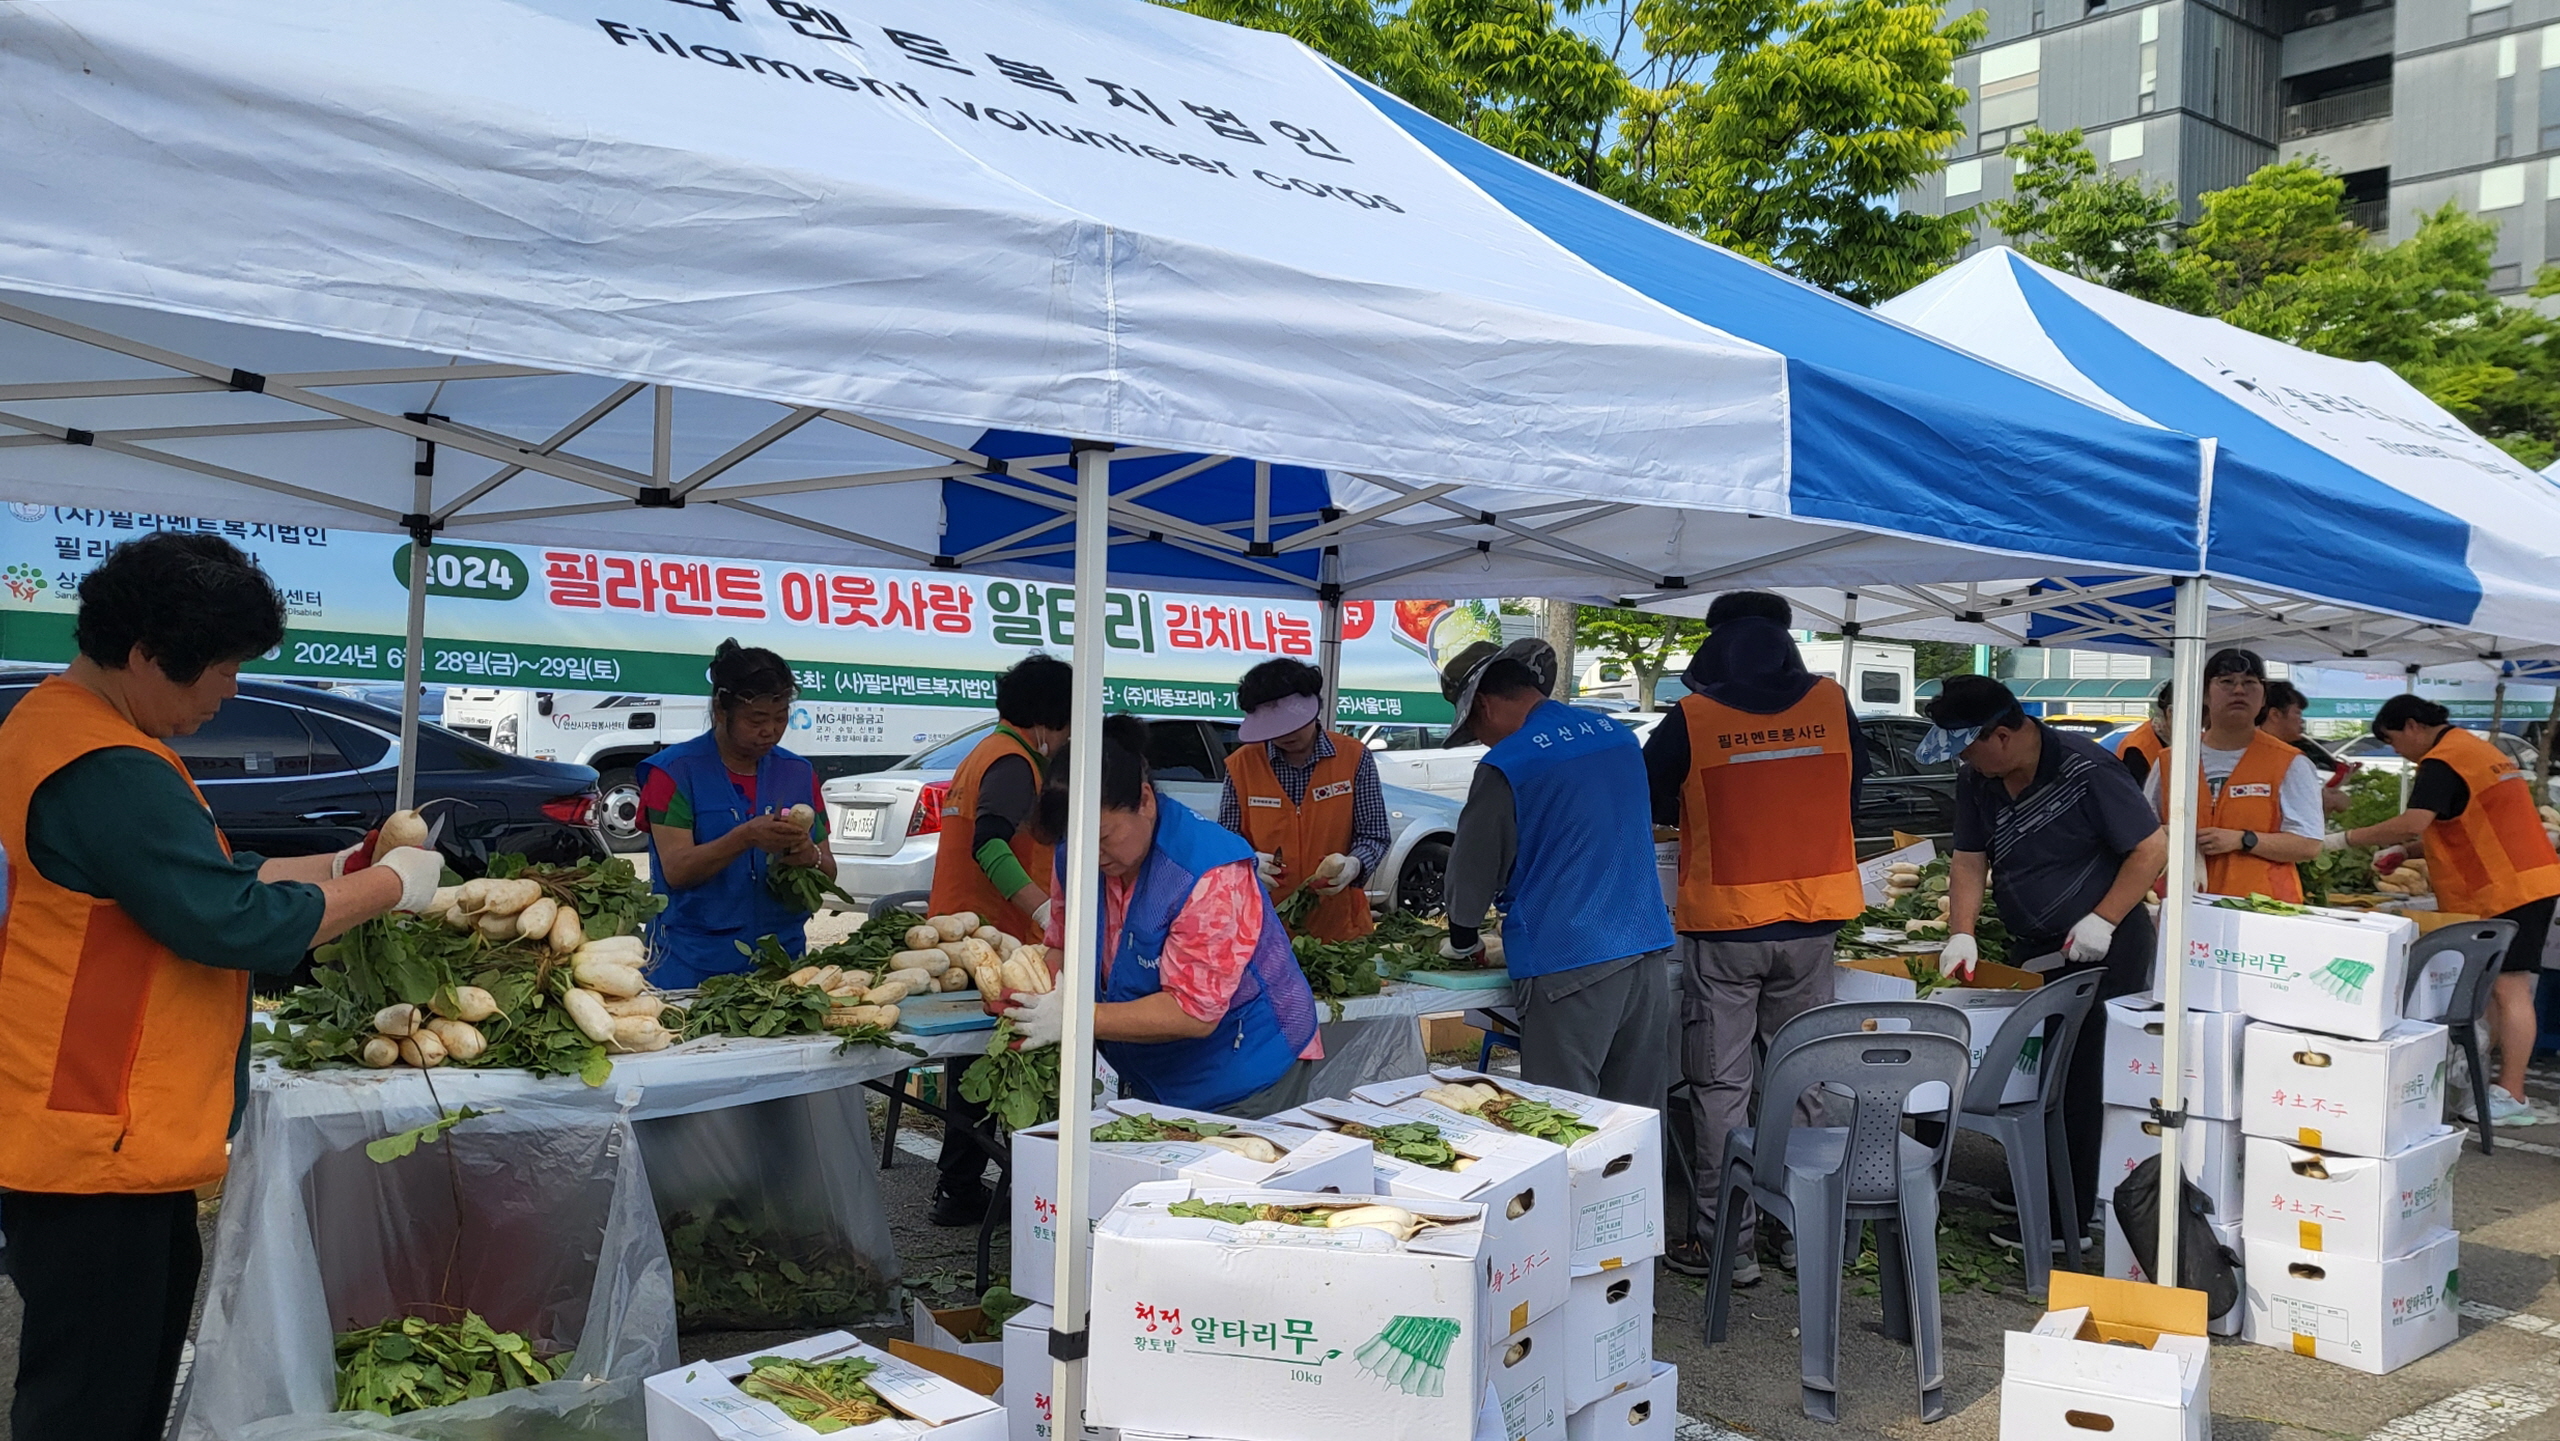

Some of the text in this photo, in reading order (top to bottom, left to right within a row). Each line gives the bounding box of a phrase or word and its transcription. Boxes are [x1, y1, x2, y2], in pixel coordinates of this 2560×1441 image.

[595, 18, 1407, 214] Filament volunteer corps
[287, 608, 322, 617] Disabled
[545, 552, 767, 619] 필라멘트
[781, 572, 972, 635] 이웃사랑
[1165, 604, 1312, 656] 김치나눔
[294, 642, 377, 669] 2024년
[834, 669, 997, 698] (사)필라멘트복지법인
[563, 720, 625, 731] 안산시자원봉사센터
[1717, 724, 1827, 749] 필라멘트봉사단
[2214, 948, 2289, 975] 알타리무
[2271, 1193, 2346, 1222] 身土不二
[1491, 1249, 1551, 1294] 身土不二
[1134, 1301, 1318, 1355] 청정 알타리무
[1290, 1369, 1322, 1386] 10kg
